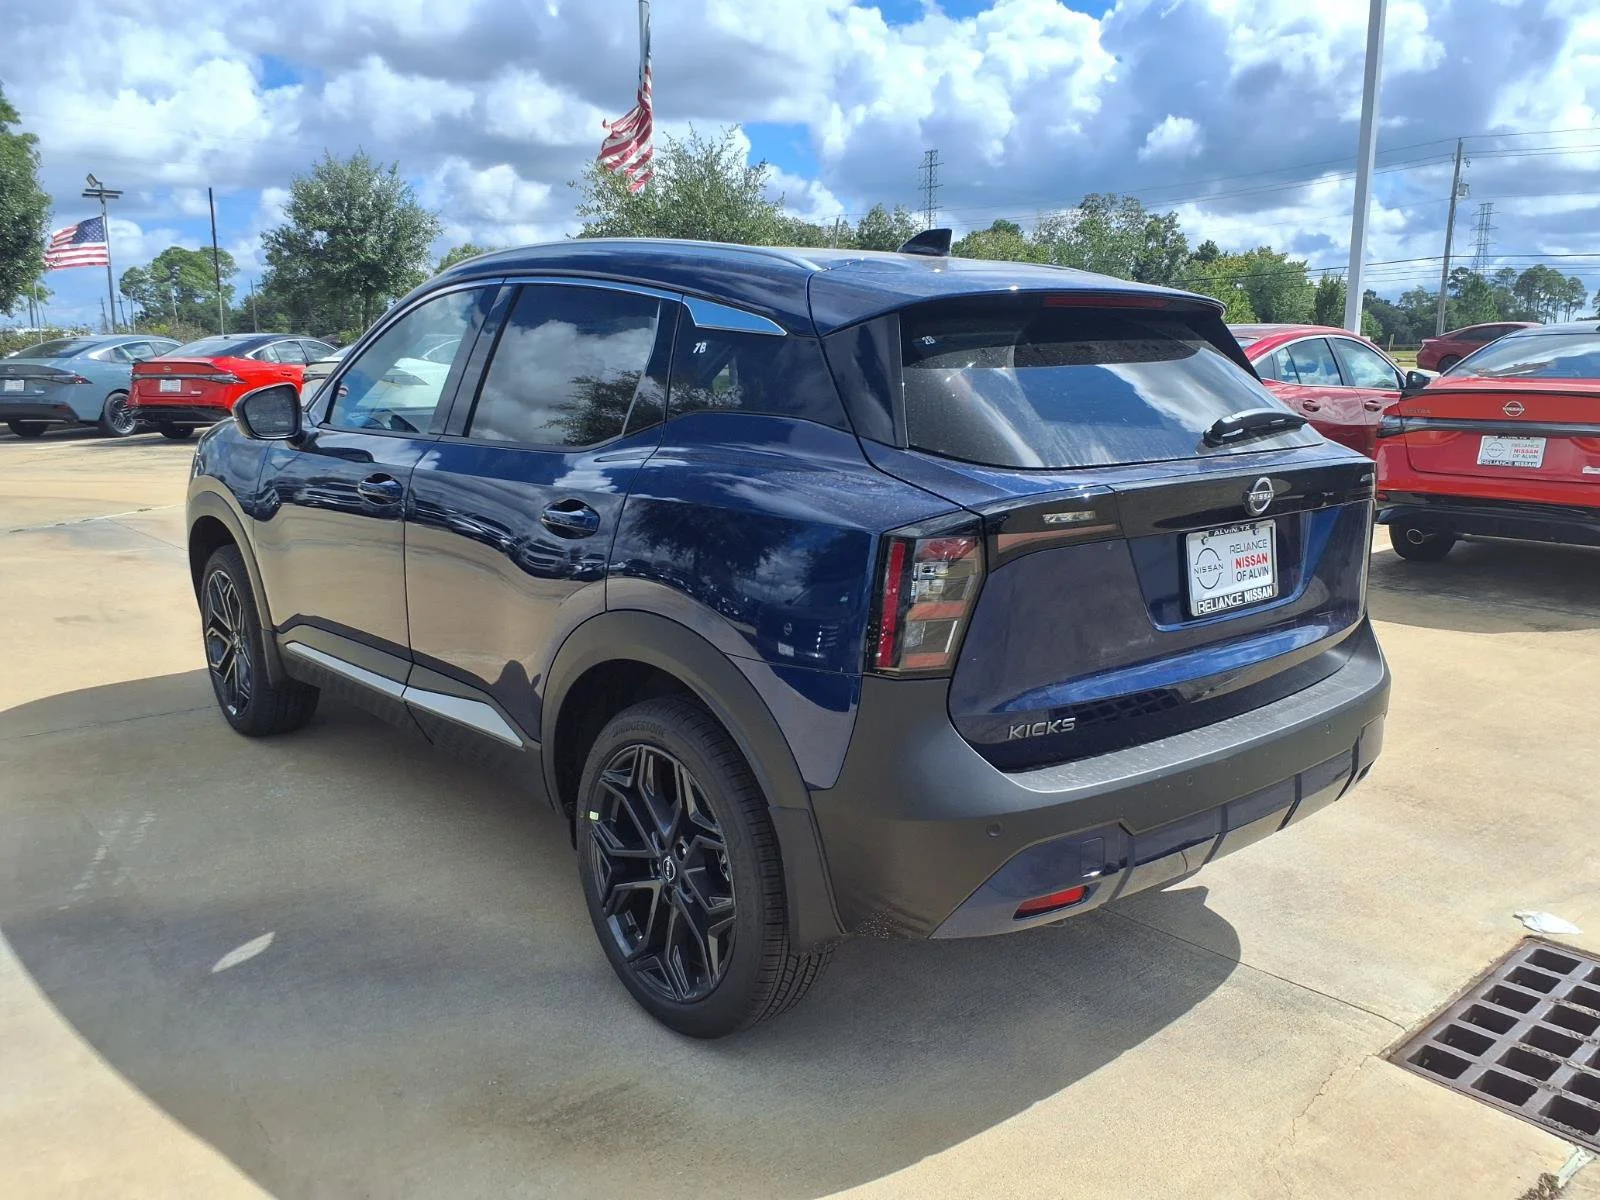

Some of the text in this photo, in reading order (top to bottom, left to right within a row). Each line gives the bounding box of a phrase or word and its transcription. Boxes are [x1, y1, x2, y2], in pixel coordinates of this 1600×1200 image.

[1213, 527, 1238, 537] ALVIN
[1229, 538, 1268, 554] RELIANCE
[1193, 563, 1224, 575] NISSAN
[1235, 553, 1268, 569] NISSAN
[1236, 566, 1269, 582] OF ALVIN
[1197, 585, 1273, 614] RELIANCE NISSAN
[1008, 717, 1076, 740] KICKS
